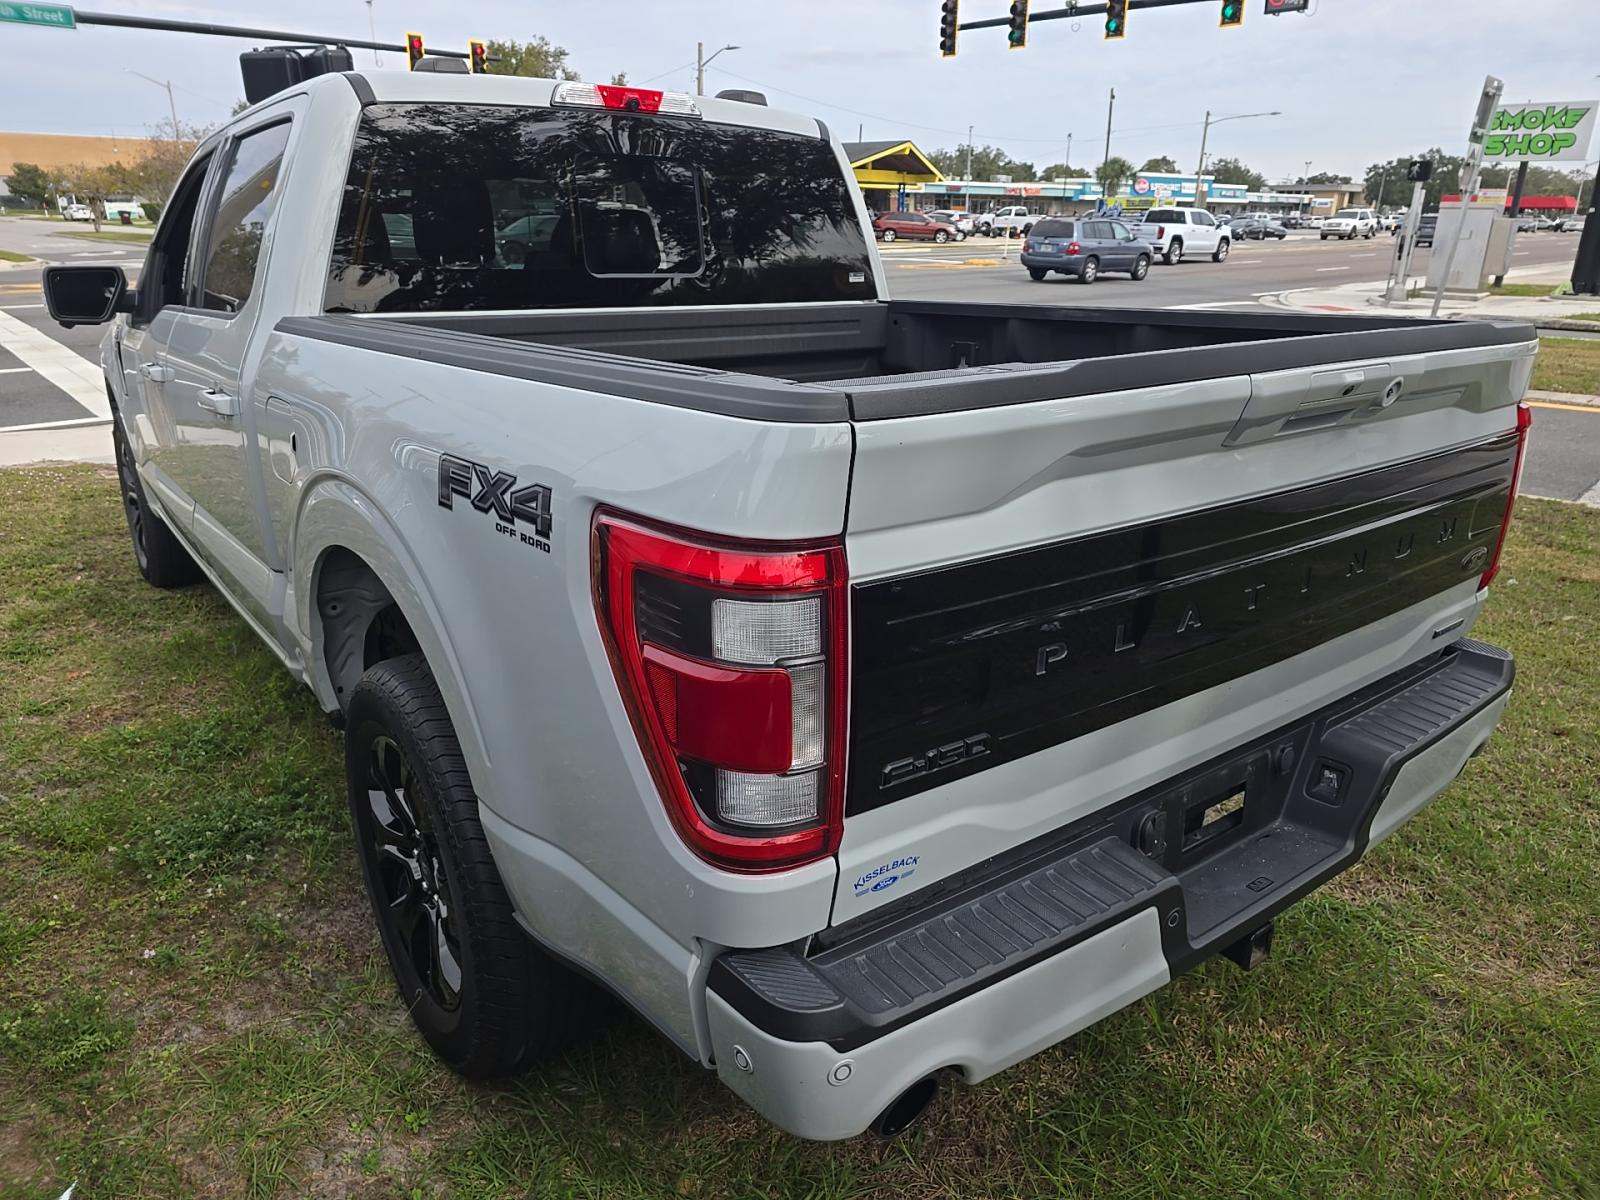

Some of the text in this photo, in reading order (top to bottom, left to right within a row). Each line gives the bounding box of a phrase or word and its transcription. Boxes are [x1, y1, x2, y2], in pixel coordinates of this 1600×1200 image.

[22, 6, 65, 21] Street
[1484, 132, 1577, 157] SHOP
[438, 452, 552, 541] FX4
[495, 522, 551, 554] OFF ROAD
[1034, 516, 1459, 677] PLATINUM
[853, 856, 920, 890] KISSELBACK
